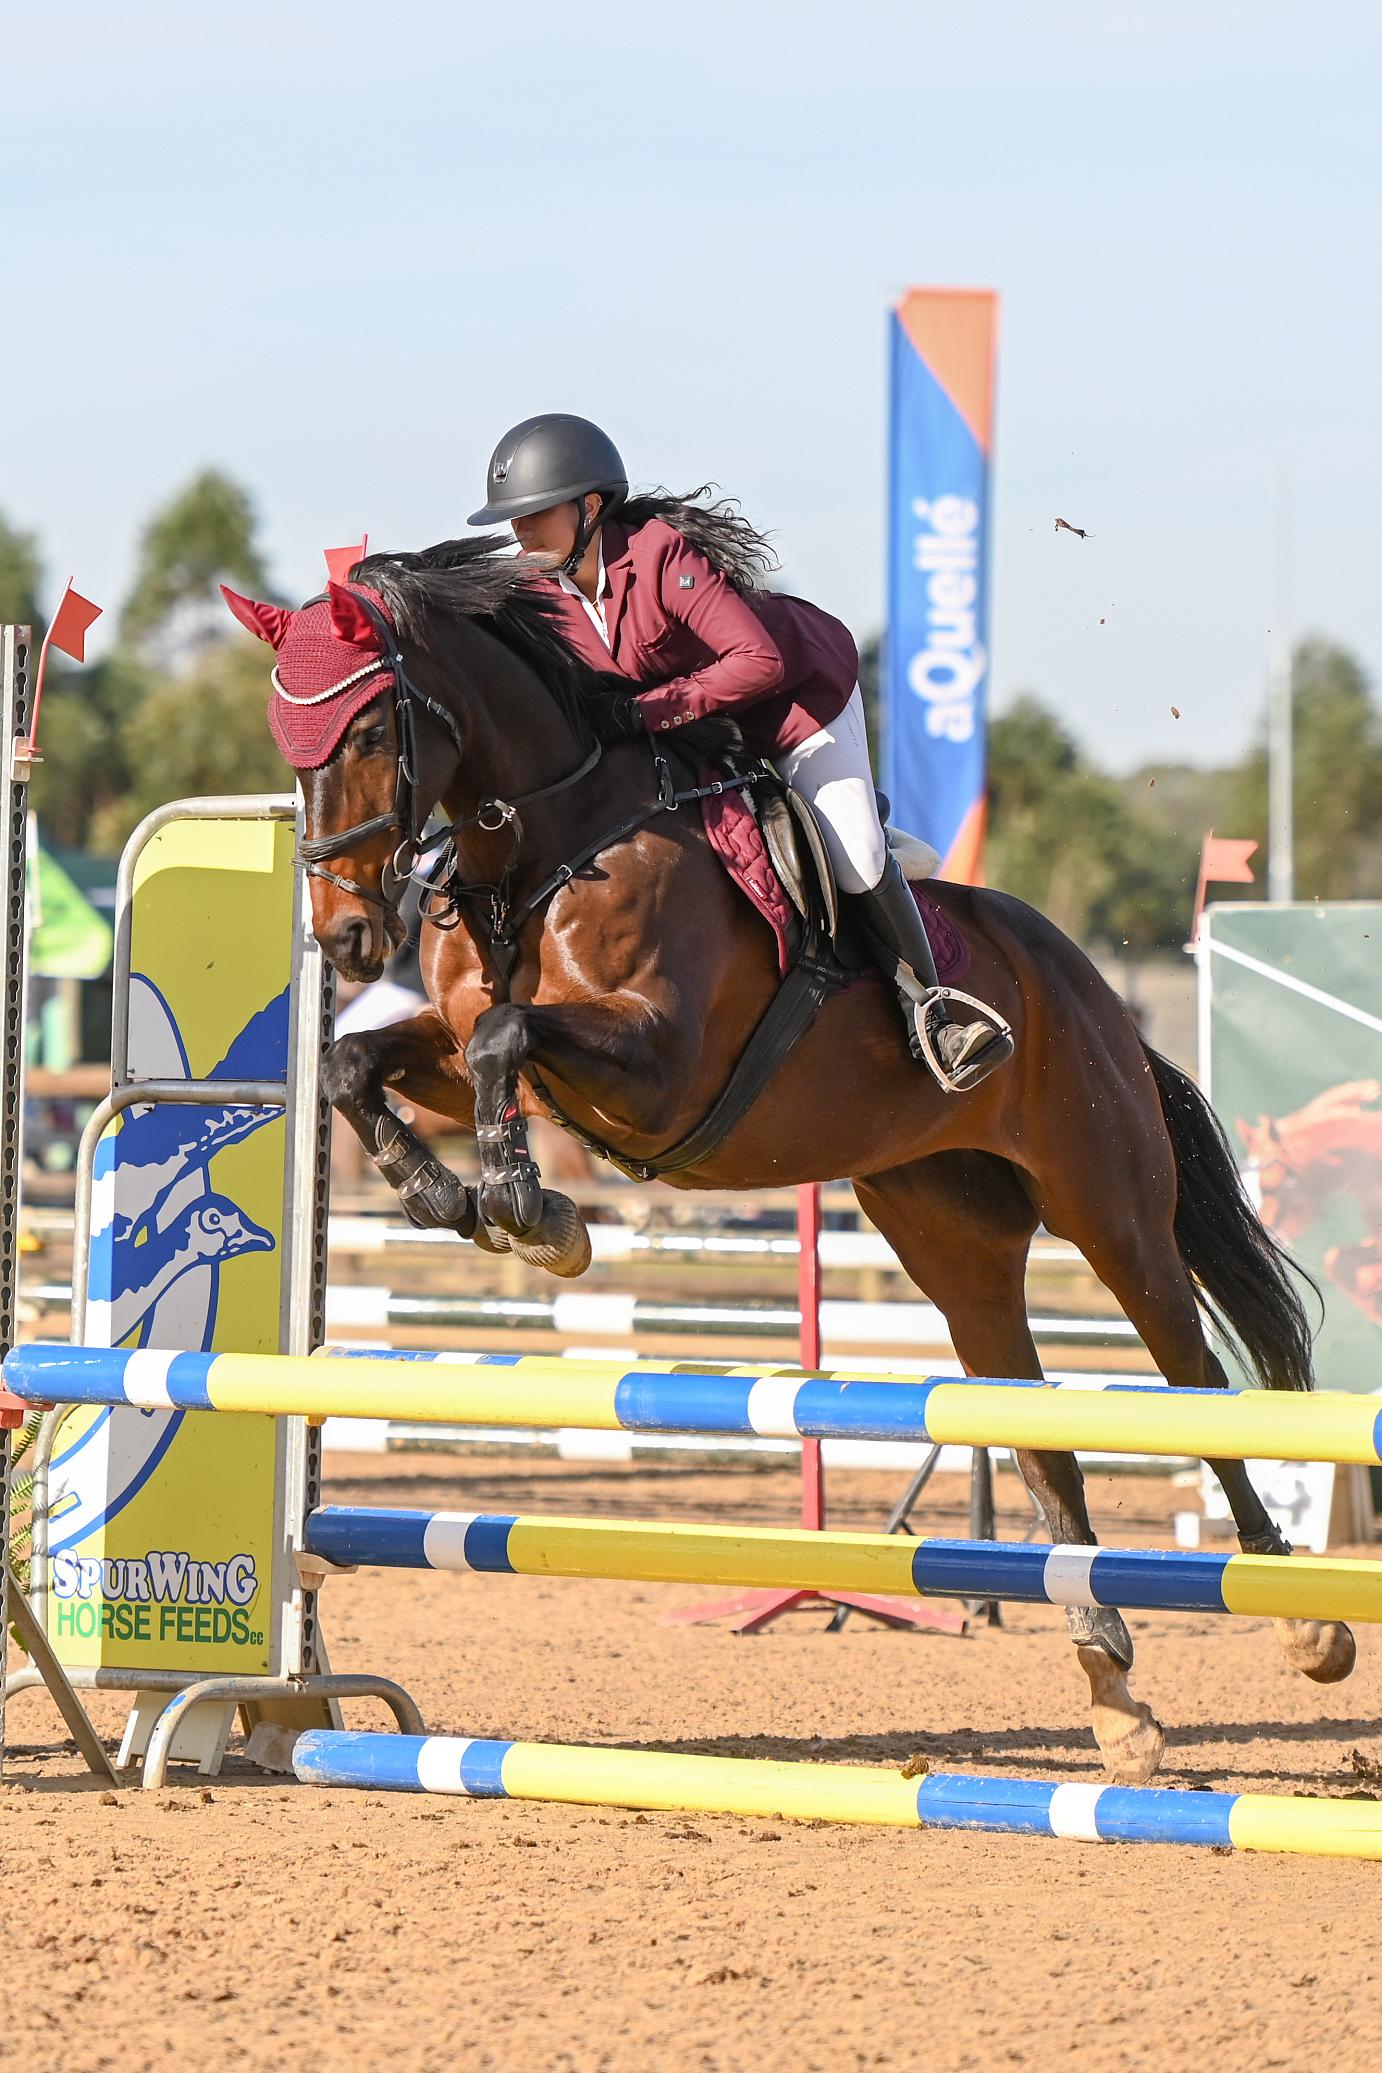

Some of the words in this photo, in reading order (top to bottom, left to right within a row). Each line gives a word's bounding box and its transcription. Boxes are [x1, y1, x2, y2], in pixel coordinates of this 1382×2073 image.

[909, 494, 986, 743] aQuellé
[57, 1602, 151, 1640] HORSE
[160, 1606, 250, 1645] FEEDS
